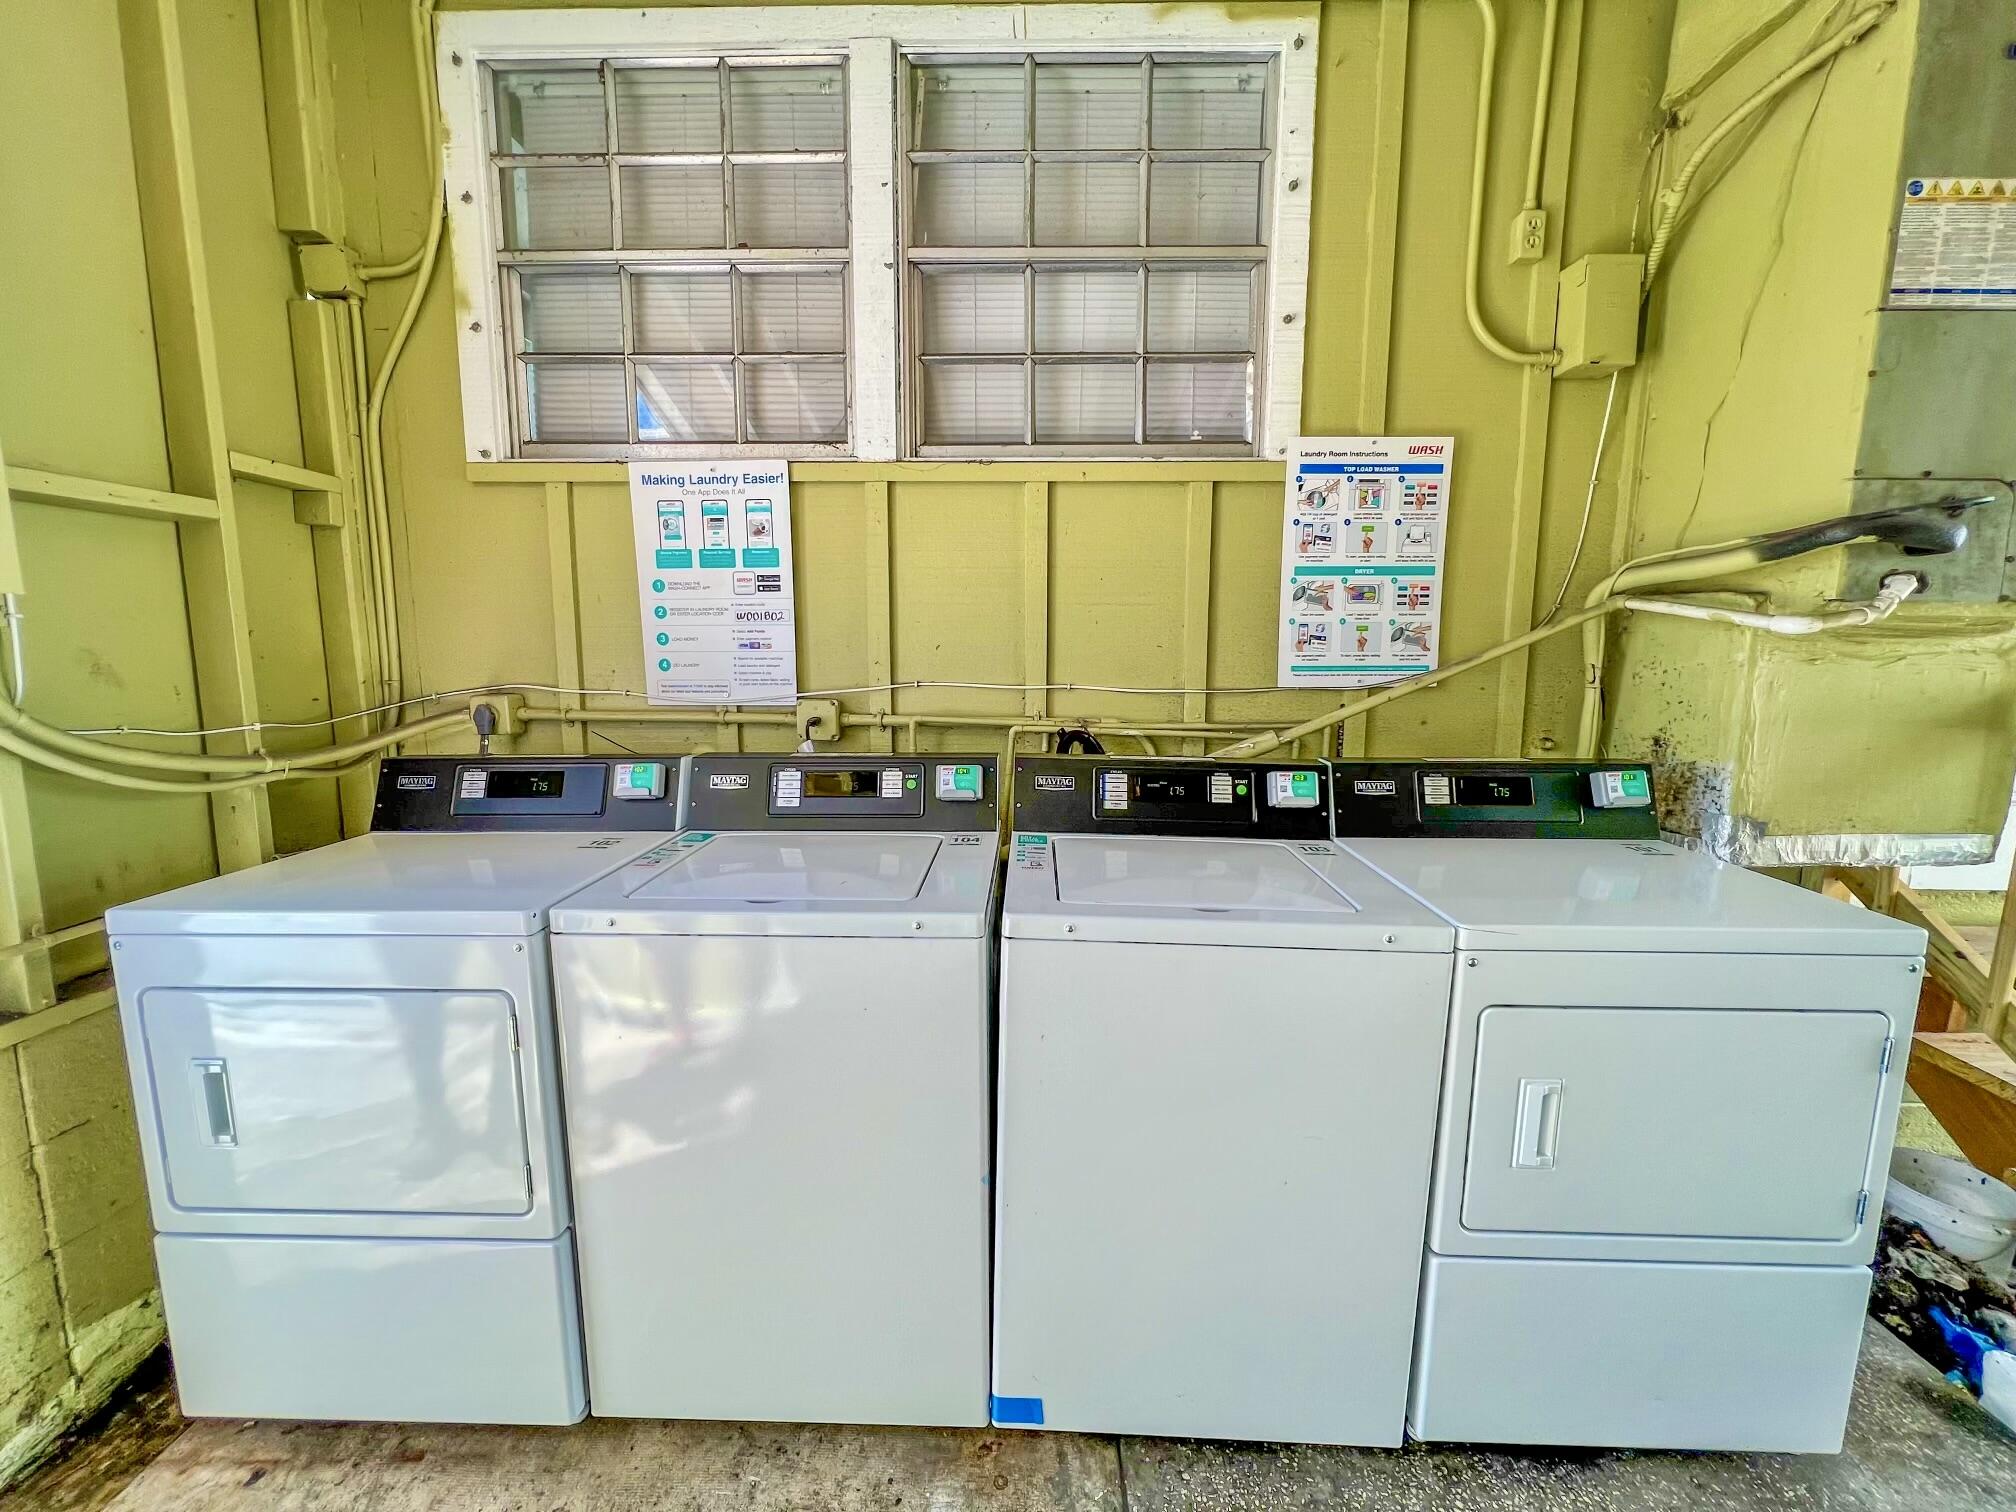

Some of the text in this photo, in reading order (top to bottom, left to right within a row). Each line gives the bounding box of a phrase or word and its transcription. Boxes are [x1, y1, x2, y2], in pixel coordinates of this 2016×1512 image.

[1300, 450, 1327, 459] Laundry
[1349, 449, 1389, 457] Instructions
[1408, 445, 1444, 455] WASH
[641, 472, 785, 488] Making Laundry Easier!
[698, 489, 711, 498] App
[658, 607, 664, 617] 2
[660, 634, 666, 643] 3
[662, 660, 668, 670] 4
[400, 777, 434, 786] MAYTAG
[713, 776, 747, 784] MAYTAG
[1037, 777, 1073, 786] MAYTAG
[1357, 782, 1393, 790] MAYTAG
